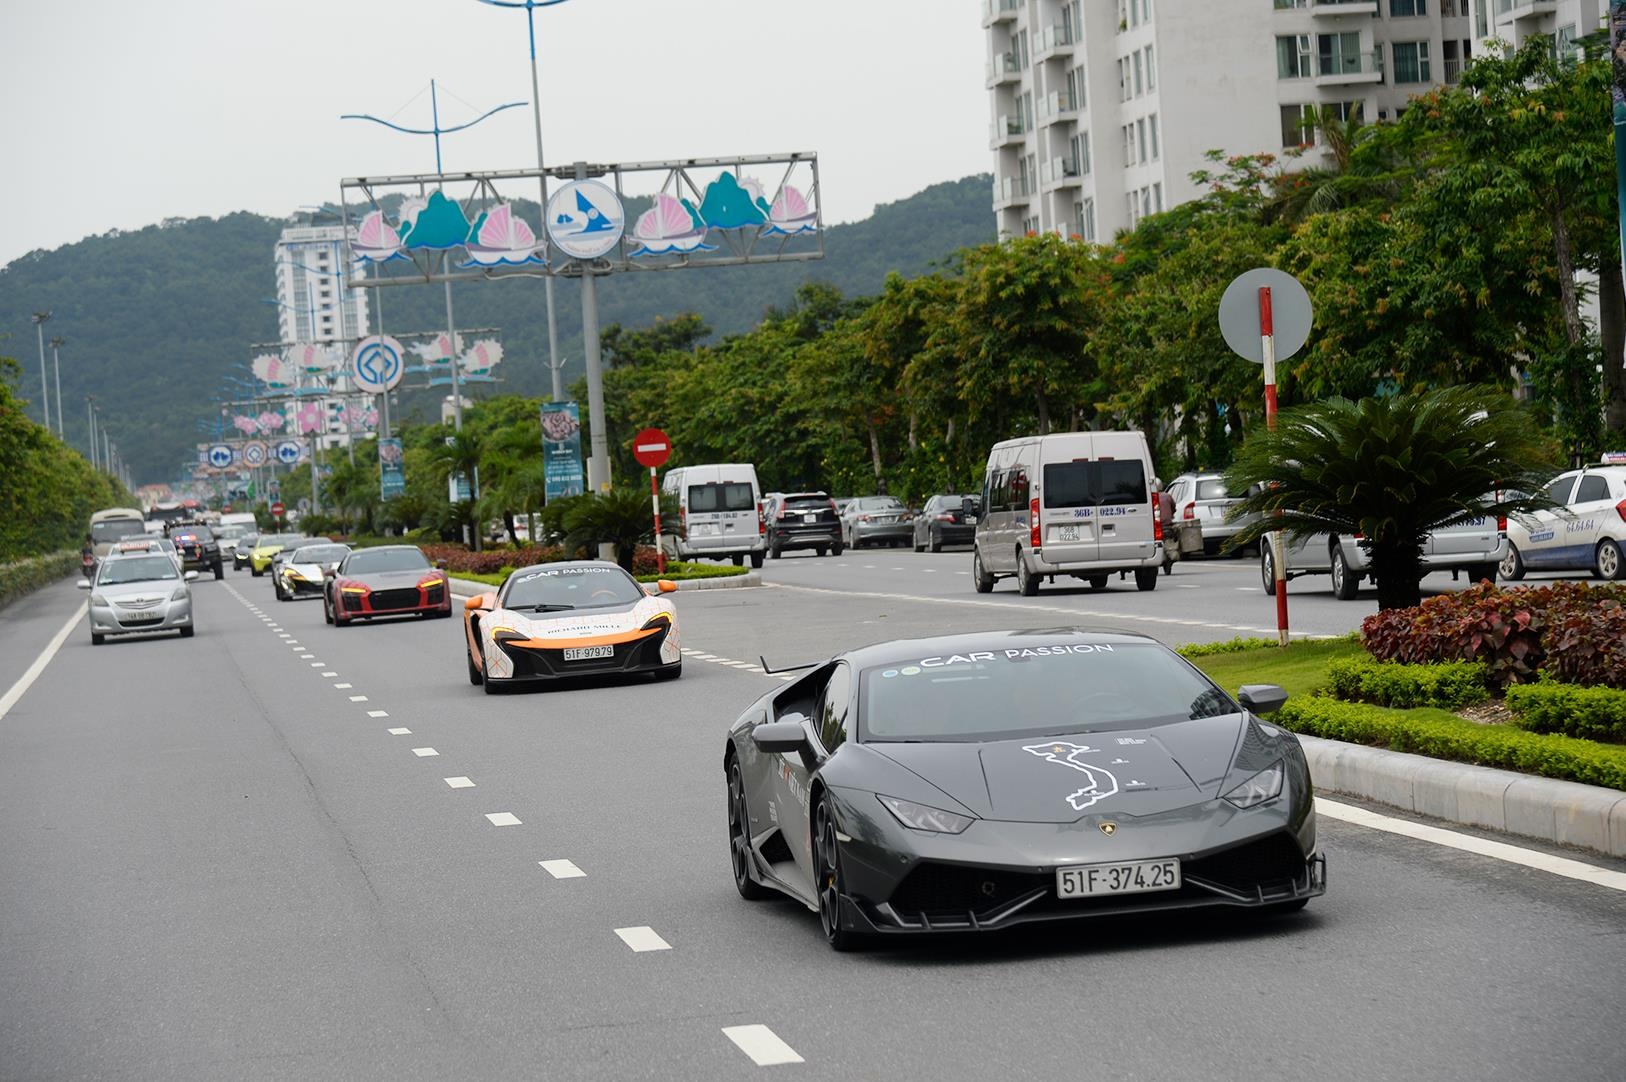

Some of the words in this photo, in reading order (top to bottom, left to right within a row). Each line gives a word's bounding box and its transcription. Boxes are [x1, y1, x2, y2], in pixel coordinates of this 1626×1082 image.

[526, 570, 560, 580] CAR
[919, 651, 997, 668] CAR
[1004, 644, 1114, 659] PASSION
[1062, 863, 1175, 894] 51F-374.25
